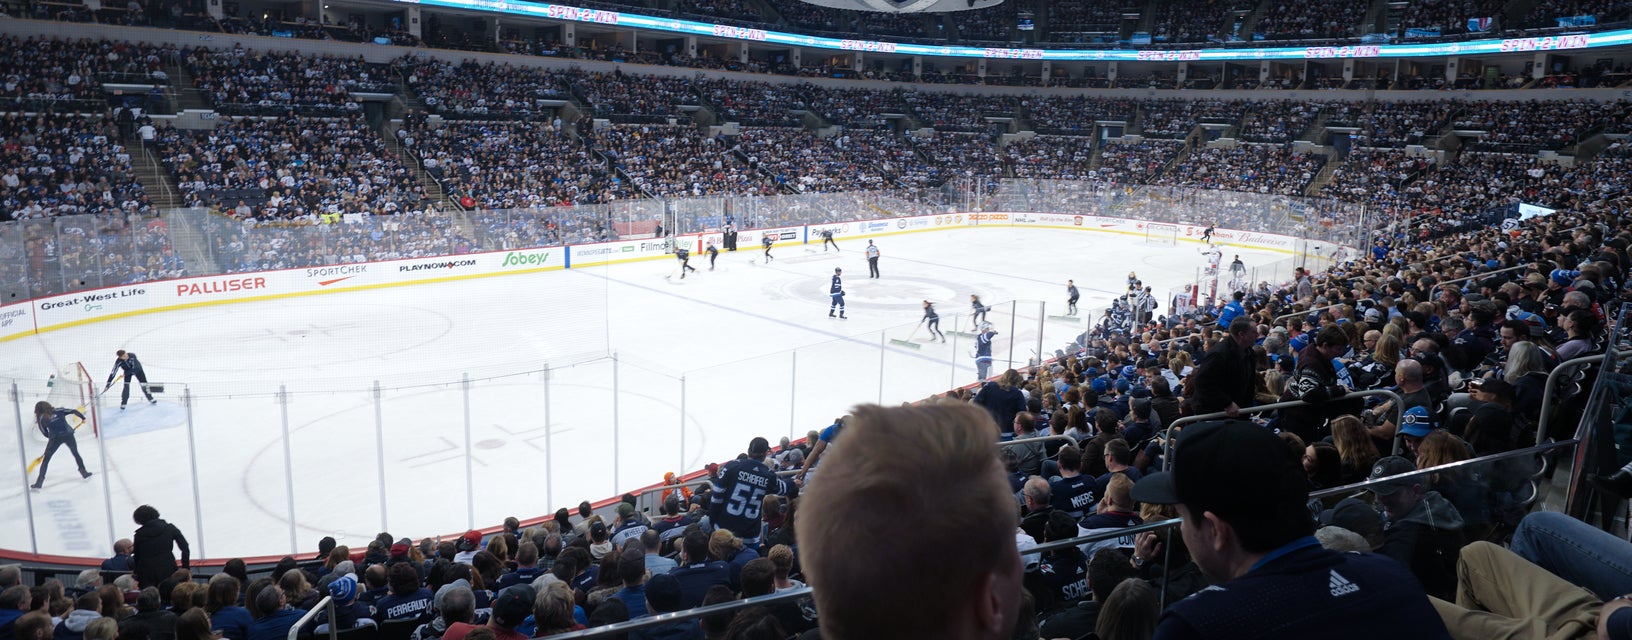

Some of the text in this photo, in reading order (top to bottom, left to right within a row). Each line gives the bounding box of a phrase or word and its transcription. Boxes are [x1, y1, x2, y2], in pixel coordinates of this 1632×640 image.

[549, 5, 617, 24] SPIN-2-WIN
[713, 24, 767, 41] SPIN-2-WIN
[840, 39, 897, 52] SPIN-2-WIN
[1500, 34, 1591, 52] SPIN-2-WIN
[983, 48, 1044, 59] SPIN-2-WIN
[1136, 49, 1200, 61] SPIN-2-WIN
[1304, 46, 1382, 58] SPIN-2-WIN
[177, 276, 266, 297] PALLISER
[41, 287, 146, 311] Great-West Life
[738, 471, 768, 487] SCHEIFELE
[727, 482, 766, 519] 55
[1070, 491, 1094, 509] MYERS
[1329, 583, 1360, 598] adidas
[387, 598, 428, 618] PERREAULT
